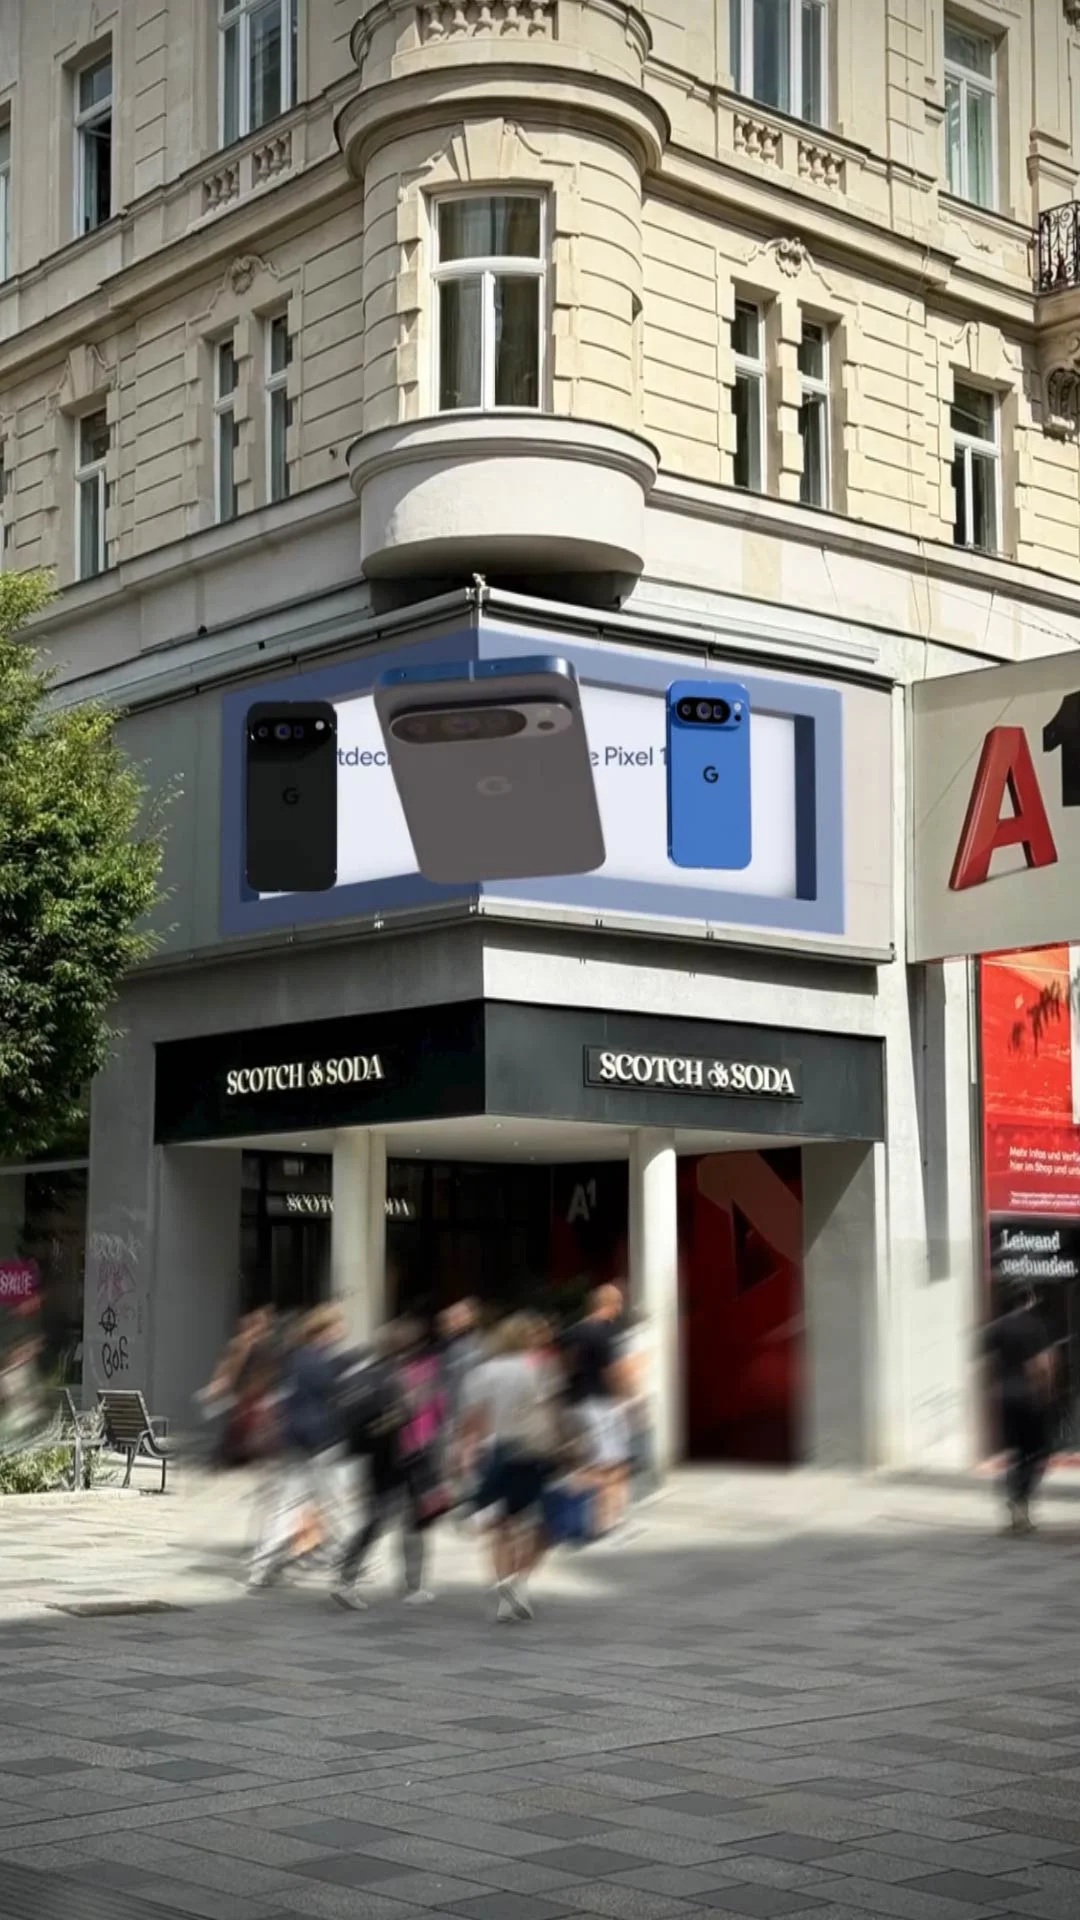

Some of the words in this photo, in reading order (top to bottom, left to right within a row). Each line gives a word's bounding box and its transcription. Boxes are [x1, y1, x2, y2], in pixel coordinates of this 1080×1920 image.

[337, 746, 391, 767] tdec
[605, 746, 653, 766] Pixel
[227, 1069, 303, 1095] SCOTCH
[308, 1061, 323, 1087] &
[326, 1054, 384, 1085] SODA
[600, 1052, 703, 1086] SCOTCH
[708, 1061, 729, 1088] &
[730, 1063, 795, 1094] SODA
[1001, 1230, 1060, 1252] Leiwand
[1001, 1254, 1078, 1277] verbunden.
